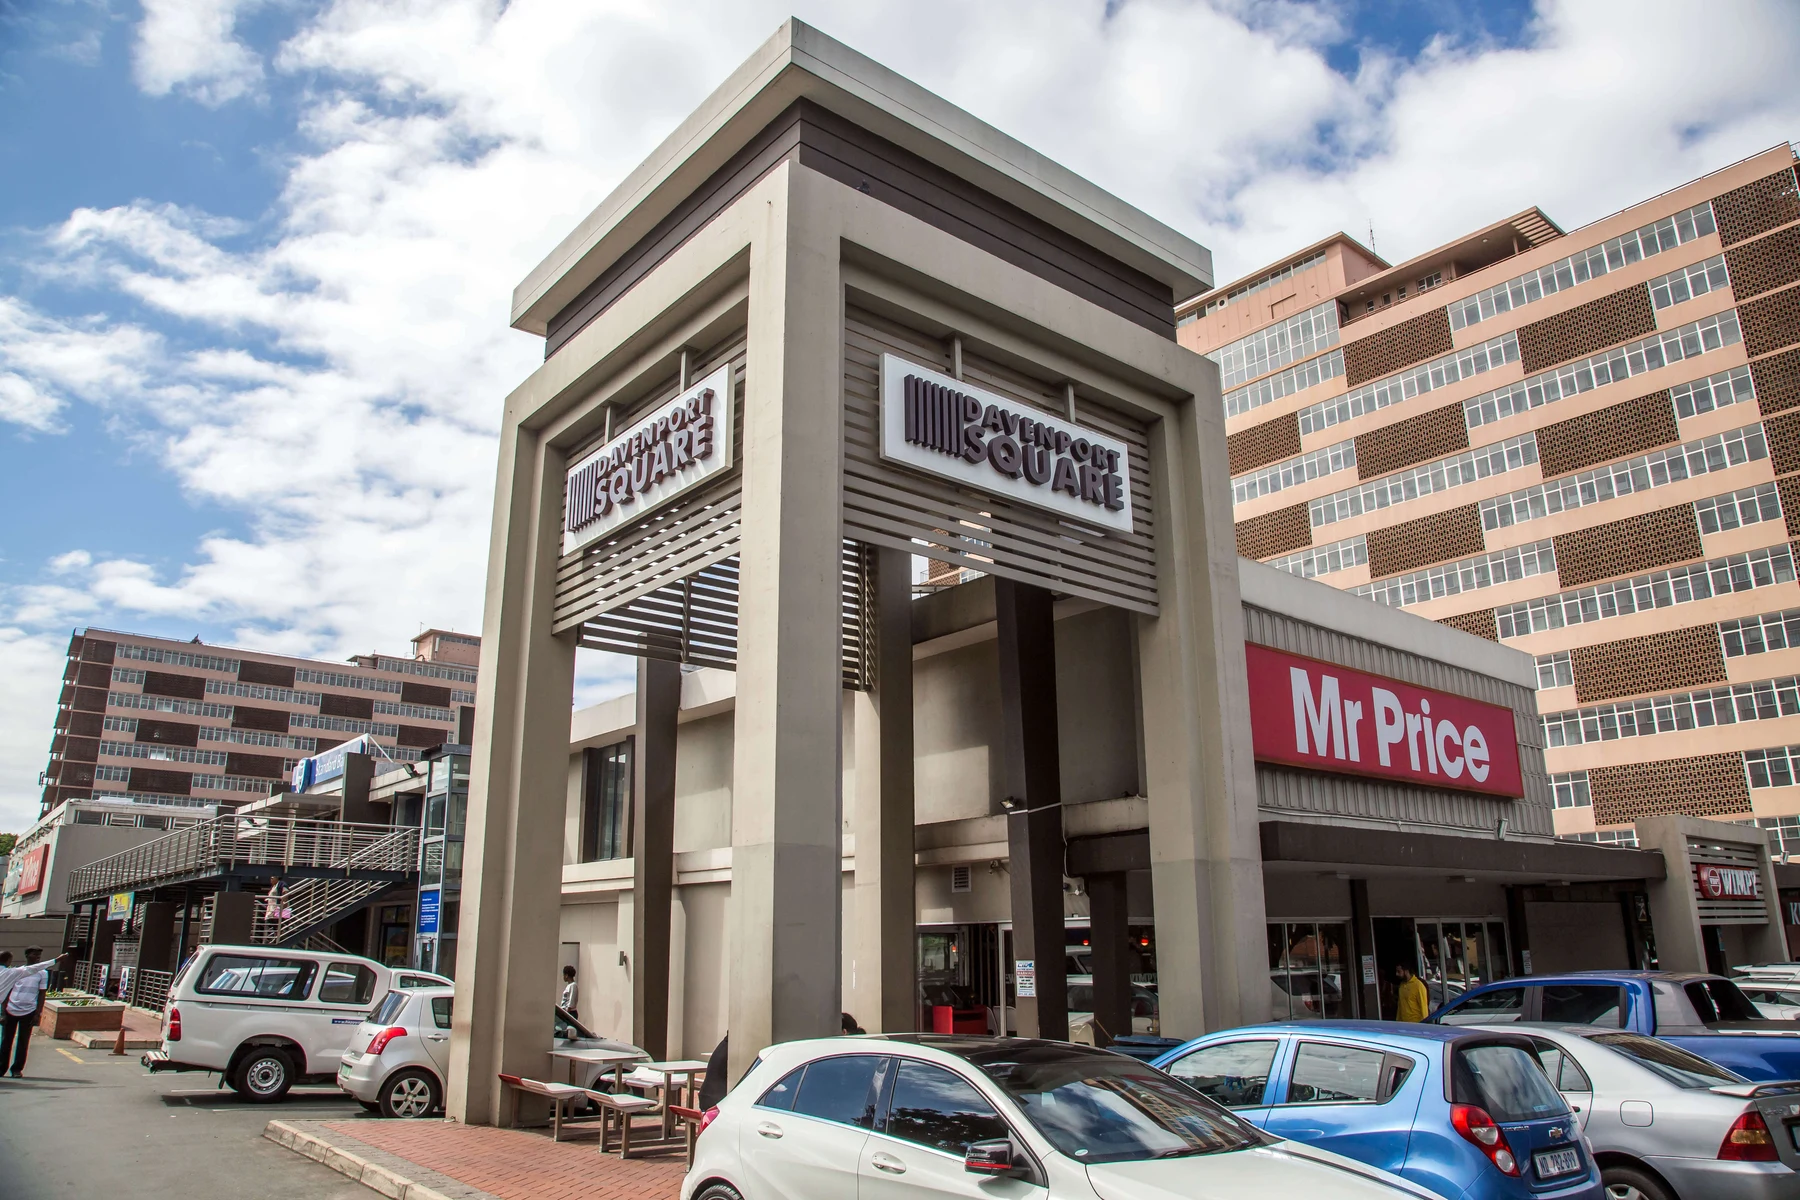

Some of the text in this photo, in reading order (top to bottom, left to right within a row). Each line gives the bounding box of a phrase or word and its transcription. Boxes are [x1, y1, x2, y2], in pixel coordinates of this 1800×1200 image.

[594, 415, 714, 516] SQUARE
[596, 388, 715, 480] DAVENPORT
[963, 395, 1120, 473] DAVENPORT
[963, 424, 1124, 511] SQUARE
[315, 754, 337, 776] Standard
[1290, 666, 1490, 783] Mr Price
[1719, 868, 1757, 896] WIMPY
